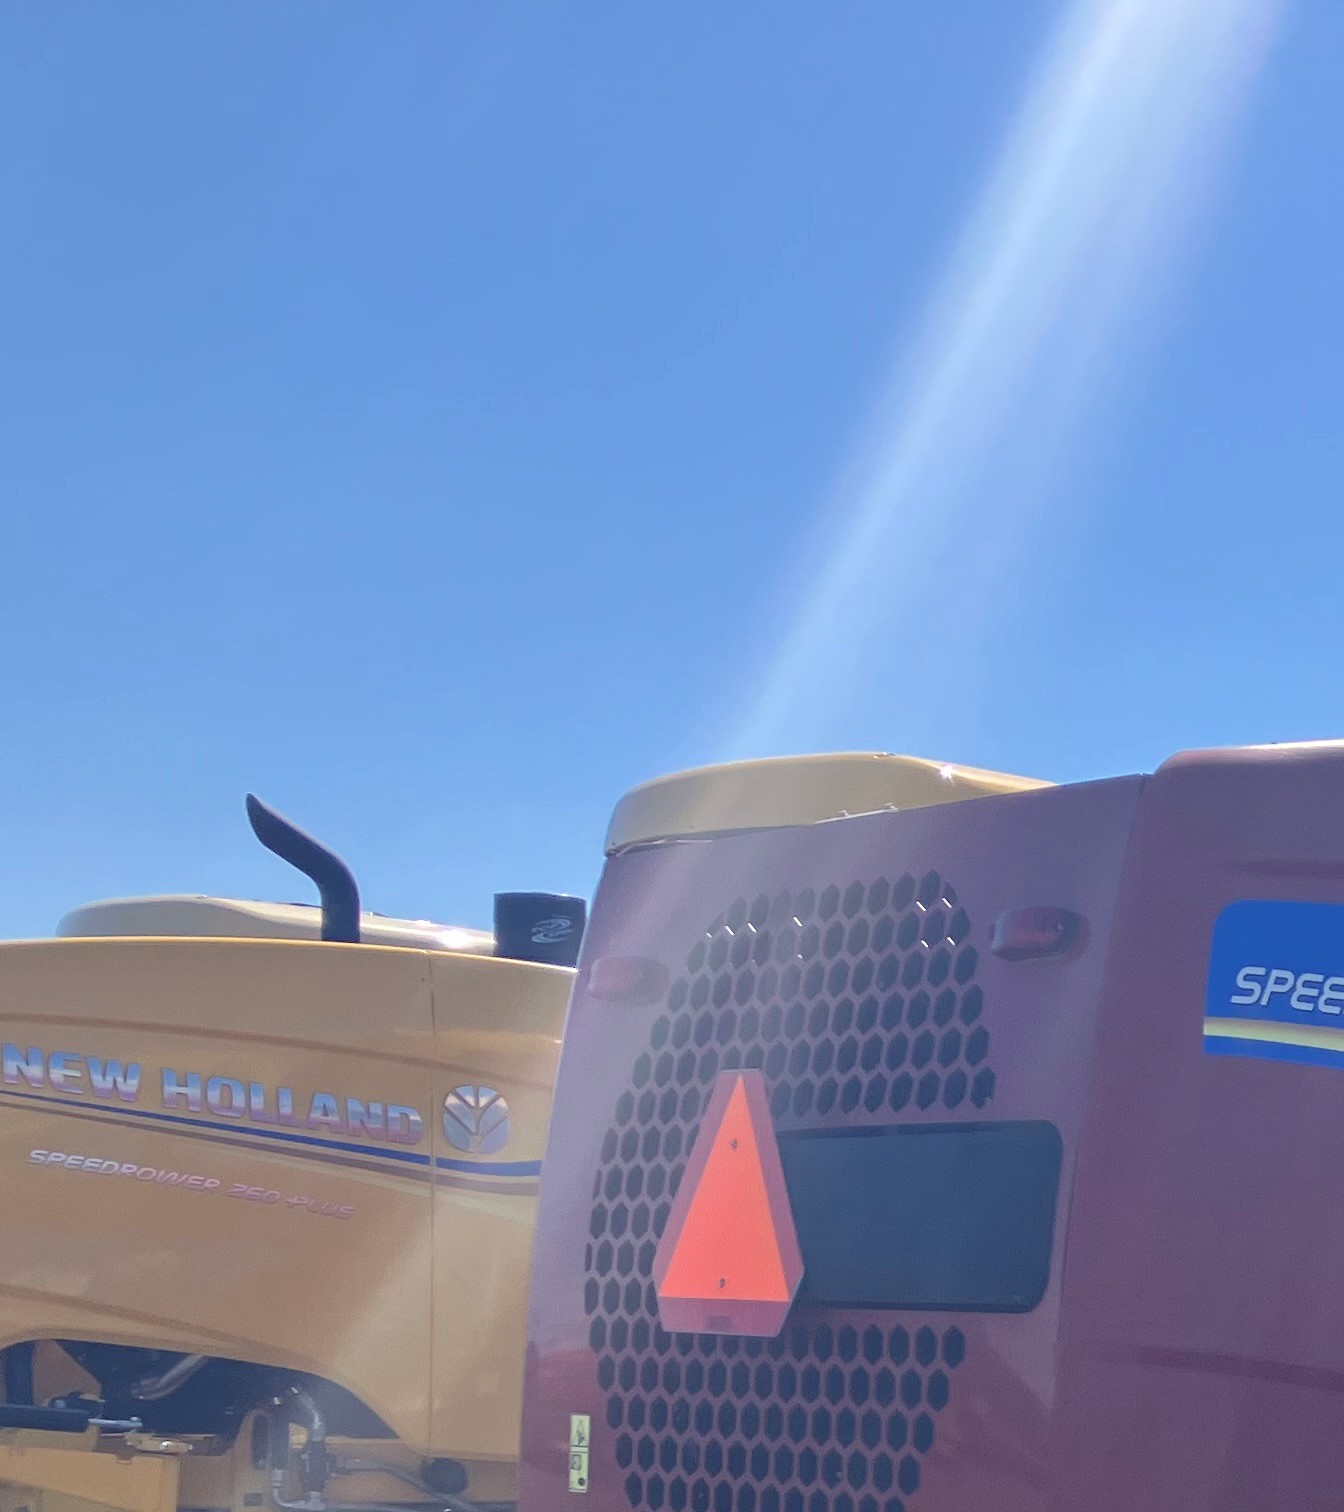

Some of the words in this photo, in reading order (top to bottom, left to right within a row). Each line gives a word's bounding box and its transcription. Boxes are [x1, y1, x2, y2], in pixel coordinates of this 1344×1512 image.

[2, 1042, 143, 1102] NEW
[161, 1067, 425, 1146] HOLLAND
[27, 1149, 222, 1193] SPEEDROWER
